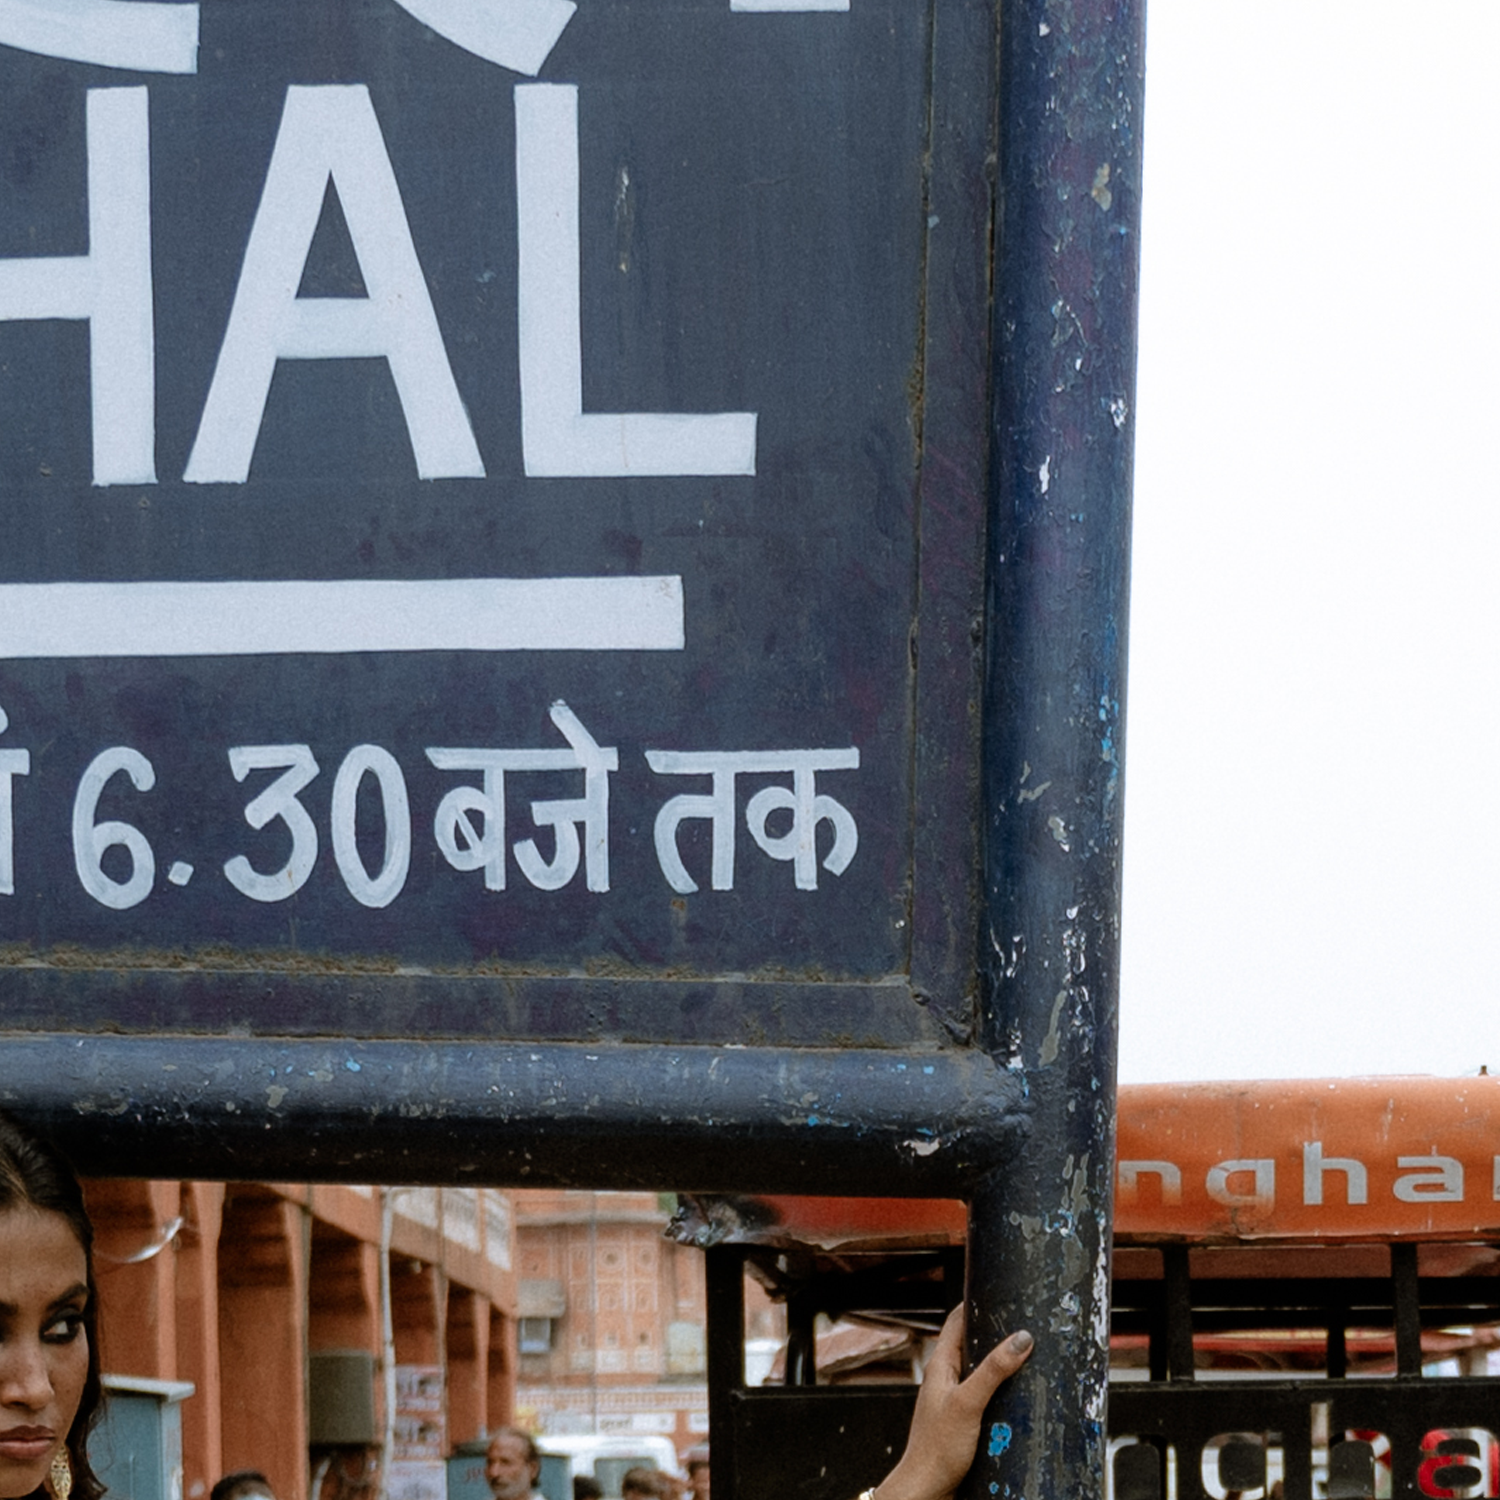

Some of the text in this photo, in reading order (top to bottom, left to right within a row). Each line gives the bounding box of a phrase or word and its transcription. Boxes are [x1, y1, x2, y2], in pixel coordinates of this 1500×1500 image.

[72, 744, 411, 909] 6.30
[425, 698, 618, 893] बजे
[645, 747, 859, 893] तक
[1116, 1141, 1500, 1220] ngha
